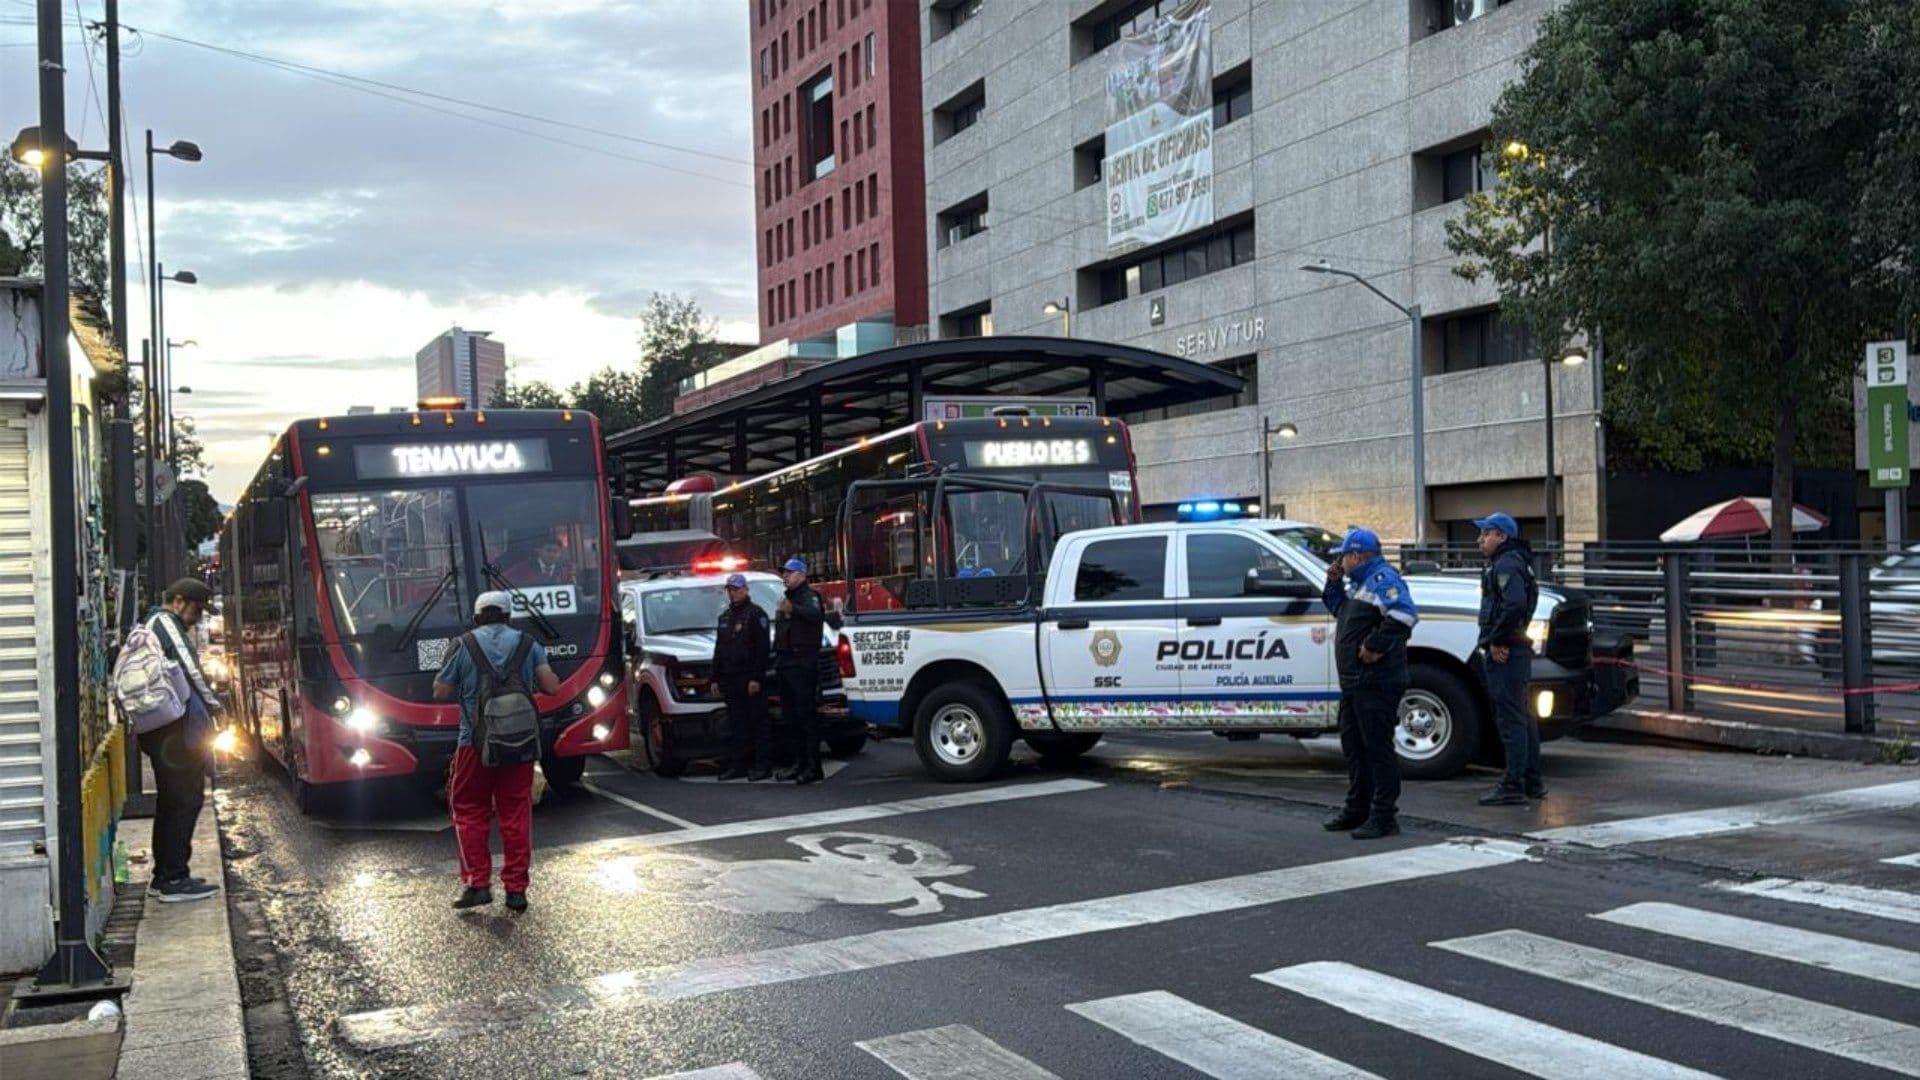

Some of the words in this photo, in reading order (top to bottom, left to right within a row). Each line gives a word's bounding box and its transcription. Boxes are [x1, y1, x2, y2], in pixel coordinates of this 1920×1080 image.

[1142, 143, 1157, 173] DE
[1158, 119, 1210, 167] OFICINAS
[1176, 317, 1265, 355] SERVYTUR
[392, 442, 522, 474] TENAYUCA
[983, 441, 1048, 466] PUEBLO
[1050, 440, 1074, 464] DE
[1075, 439, 1089, 463] S
[512, 590, 571, 612] 9418
[853, 631, 892, 643] SECTOR
[1156, 630, 1290, 661] POLICÍA
[1201, 662, 1232, 670] MÉXICO
[1094, 676, 1122, 688] SSC
[1216, 672, 1249, 686] POLICÍA
[1252, 674, 1293, 686] AUXILIAR
